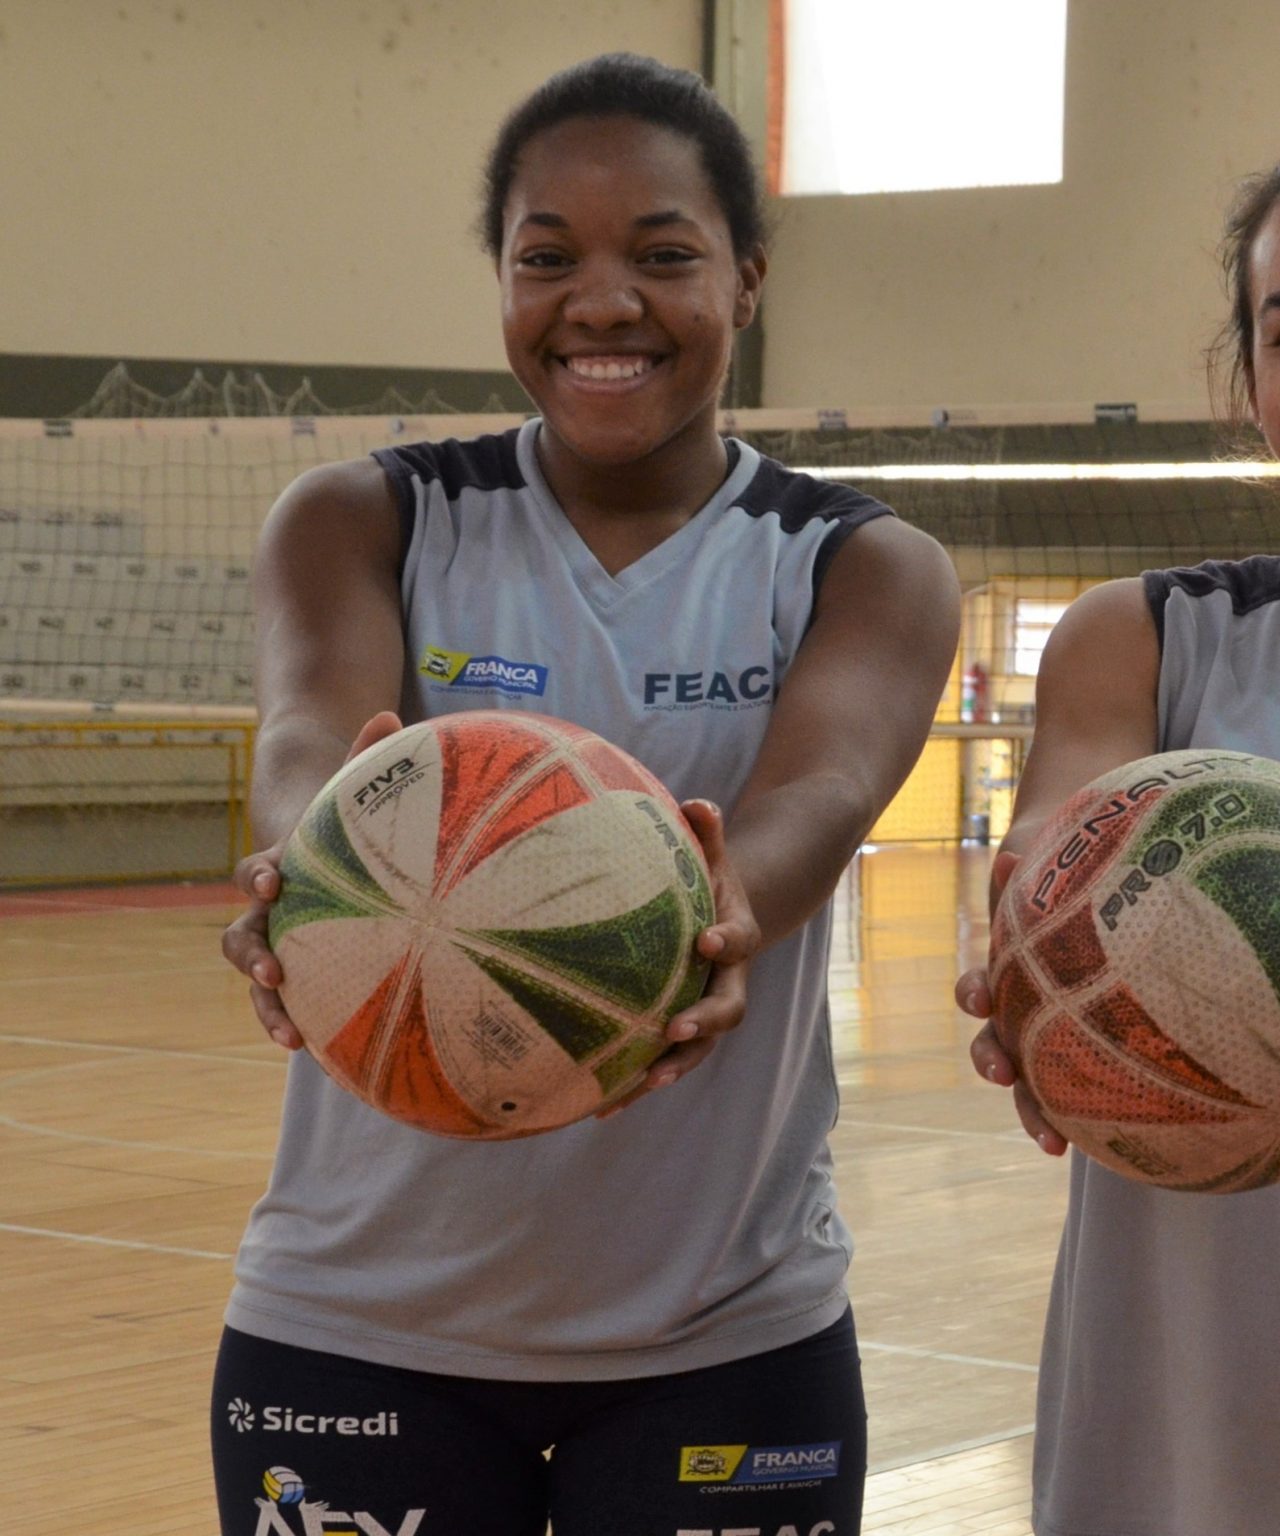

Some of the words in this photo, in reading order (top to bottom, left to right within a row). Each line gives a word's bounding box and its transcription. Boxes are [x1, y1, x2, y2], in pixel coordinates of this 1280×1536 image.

[465, 661, 539, 683] FRANCA
[643, 665, 770, 704] FEAC
[369, 771, 425, 816] APPROVED
[1180, 793, 1246, 842] 7.0
[1031, 757, 1254, 911] PENALTY
[262, 1406, 399, 1436] Sicredi
[752, 1449, 836, 1468] FRANCA
[752, 1464, 799, 1476] GOVERNO
[700, 1483, 778, 1494] COMPARTILHAR
